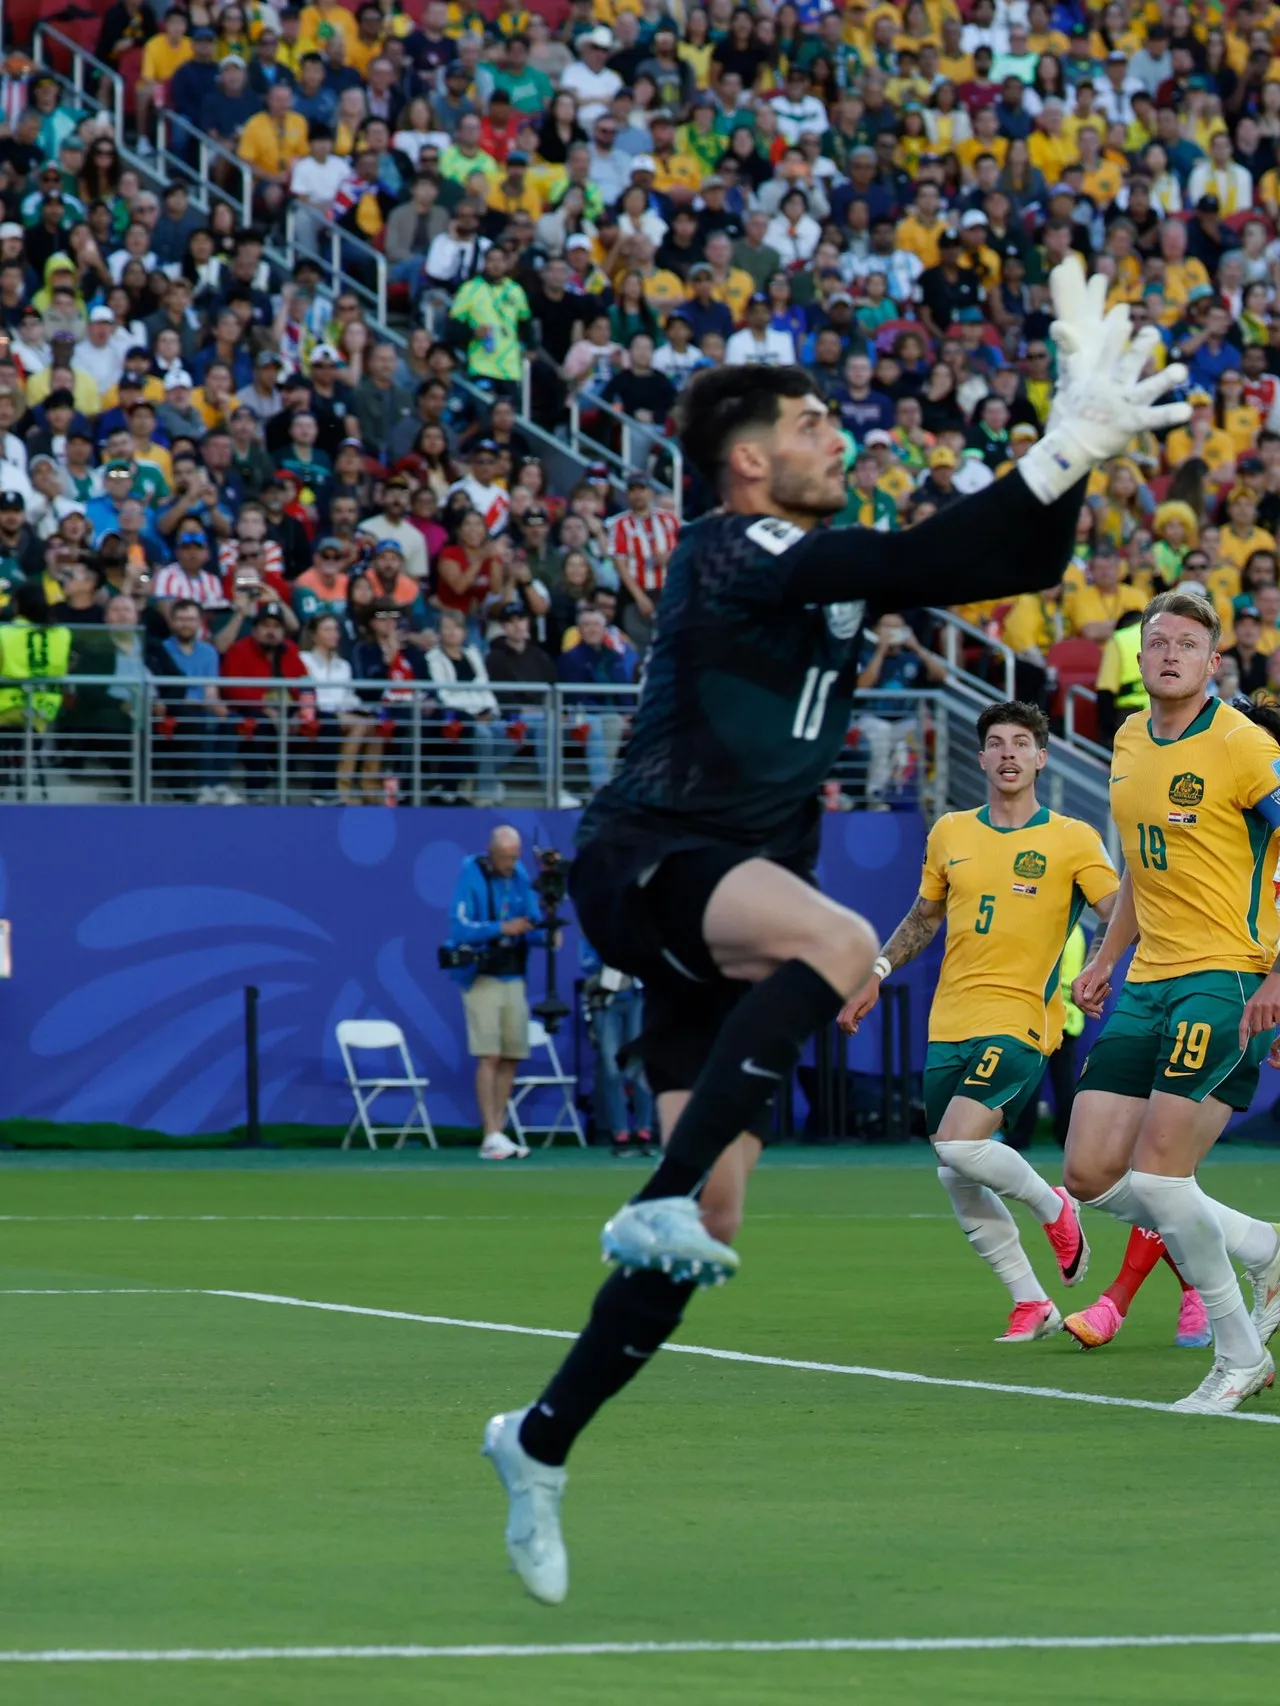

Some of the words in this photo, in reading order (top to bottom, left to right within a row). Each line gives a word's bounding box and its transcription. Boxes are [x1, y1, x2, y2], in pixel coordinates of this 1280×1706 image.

[1137, 823, 1167, 871] 19
[975, 895, 996, 935] 5
[976, 1047, 1004, 1078] 5
[1169, 1021, 1212, 1070] 19
